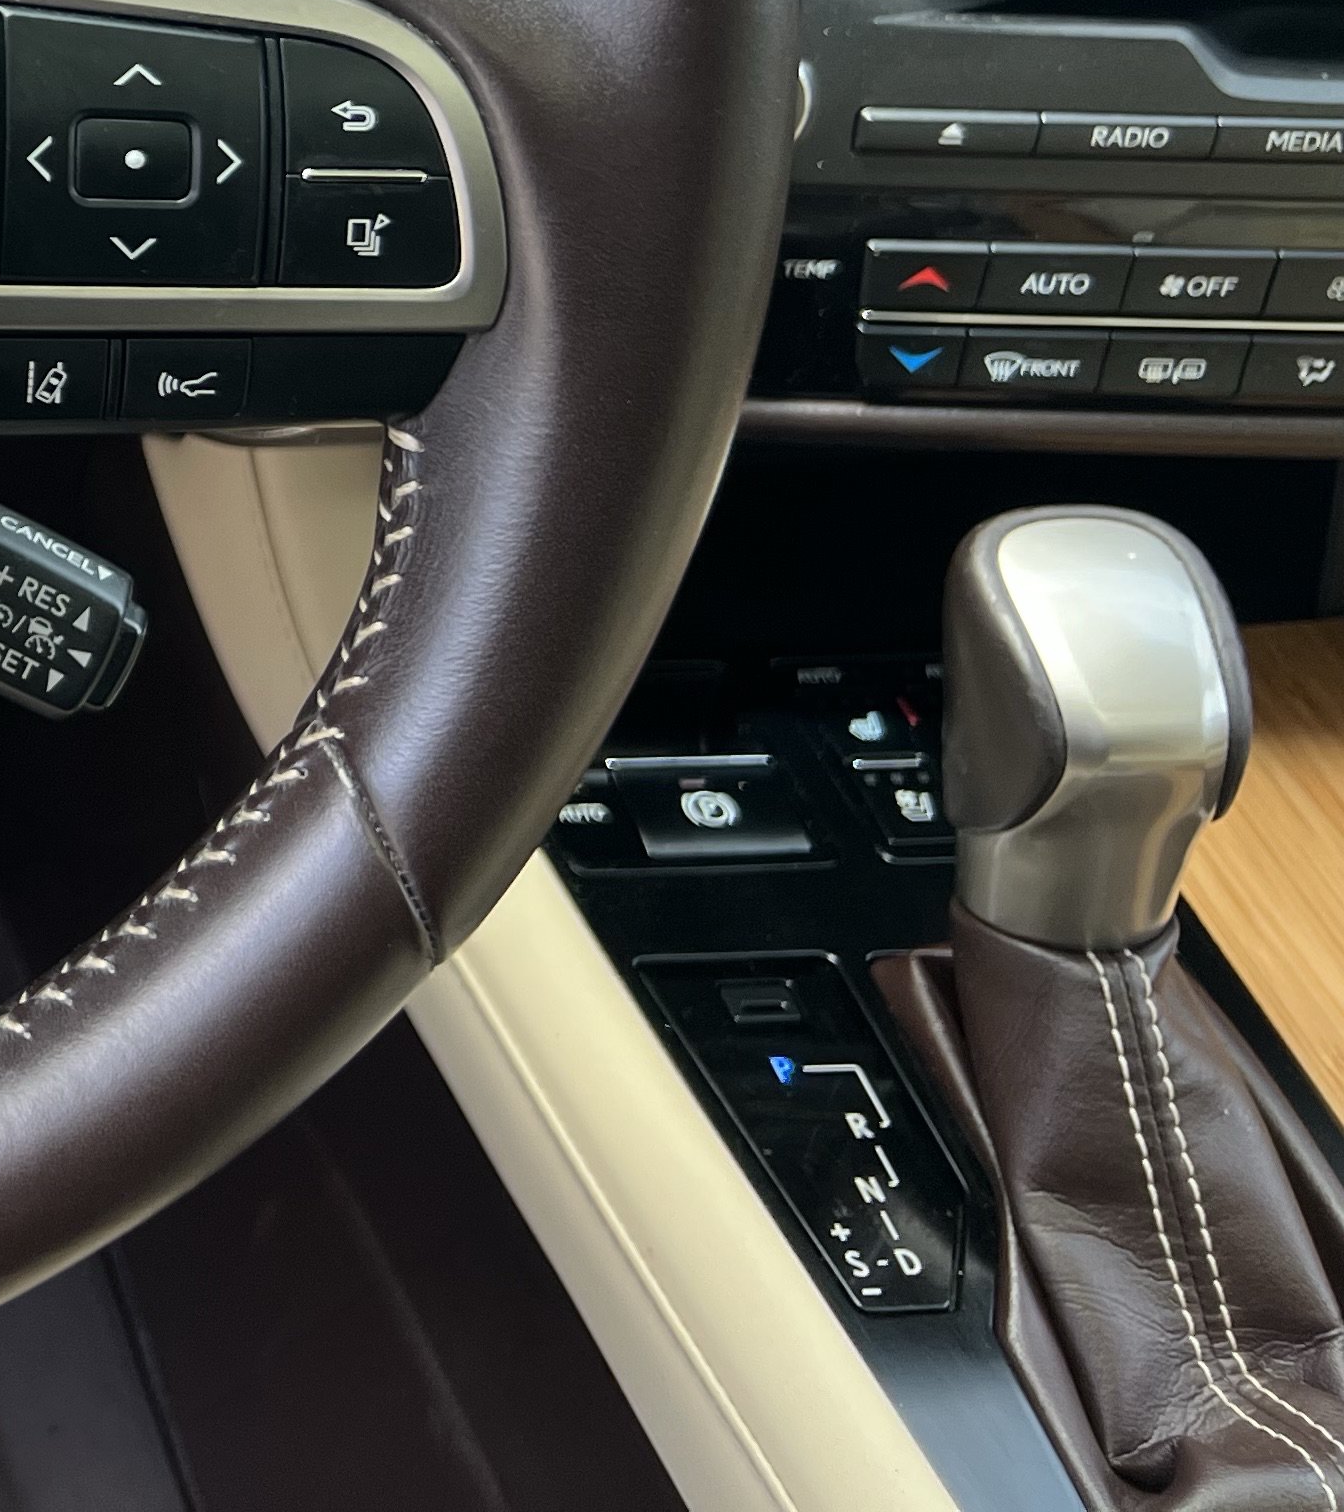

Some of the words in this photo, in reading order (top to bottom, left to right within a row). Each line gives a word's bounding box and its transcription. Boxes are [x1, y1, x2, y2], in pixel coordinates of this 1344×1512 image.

[1090, 125, 1170, 149] RADIO
[1266, 130, 1343, 153] MEDIA
[1020, 272, 1091, 296] AUTO
[1186, 275, 1239, 298] OFF
[1020, 358, 1081, 378] FRONT
[0, 516, 95, 576] CANCEL
[17, 576, 71, 618] RES
[768, 1056, 796, 1083] P
[845, 1113, 875, 1139] R
[854, 1176, 887, 1203] N
[844, 1250, 870, 1277] S
[893, 1248, 922, 1276] D
